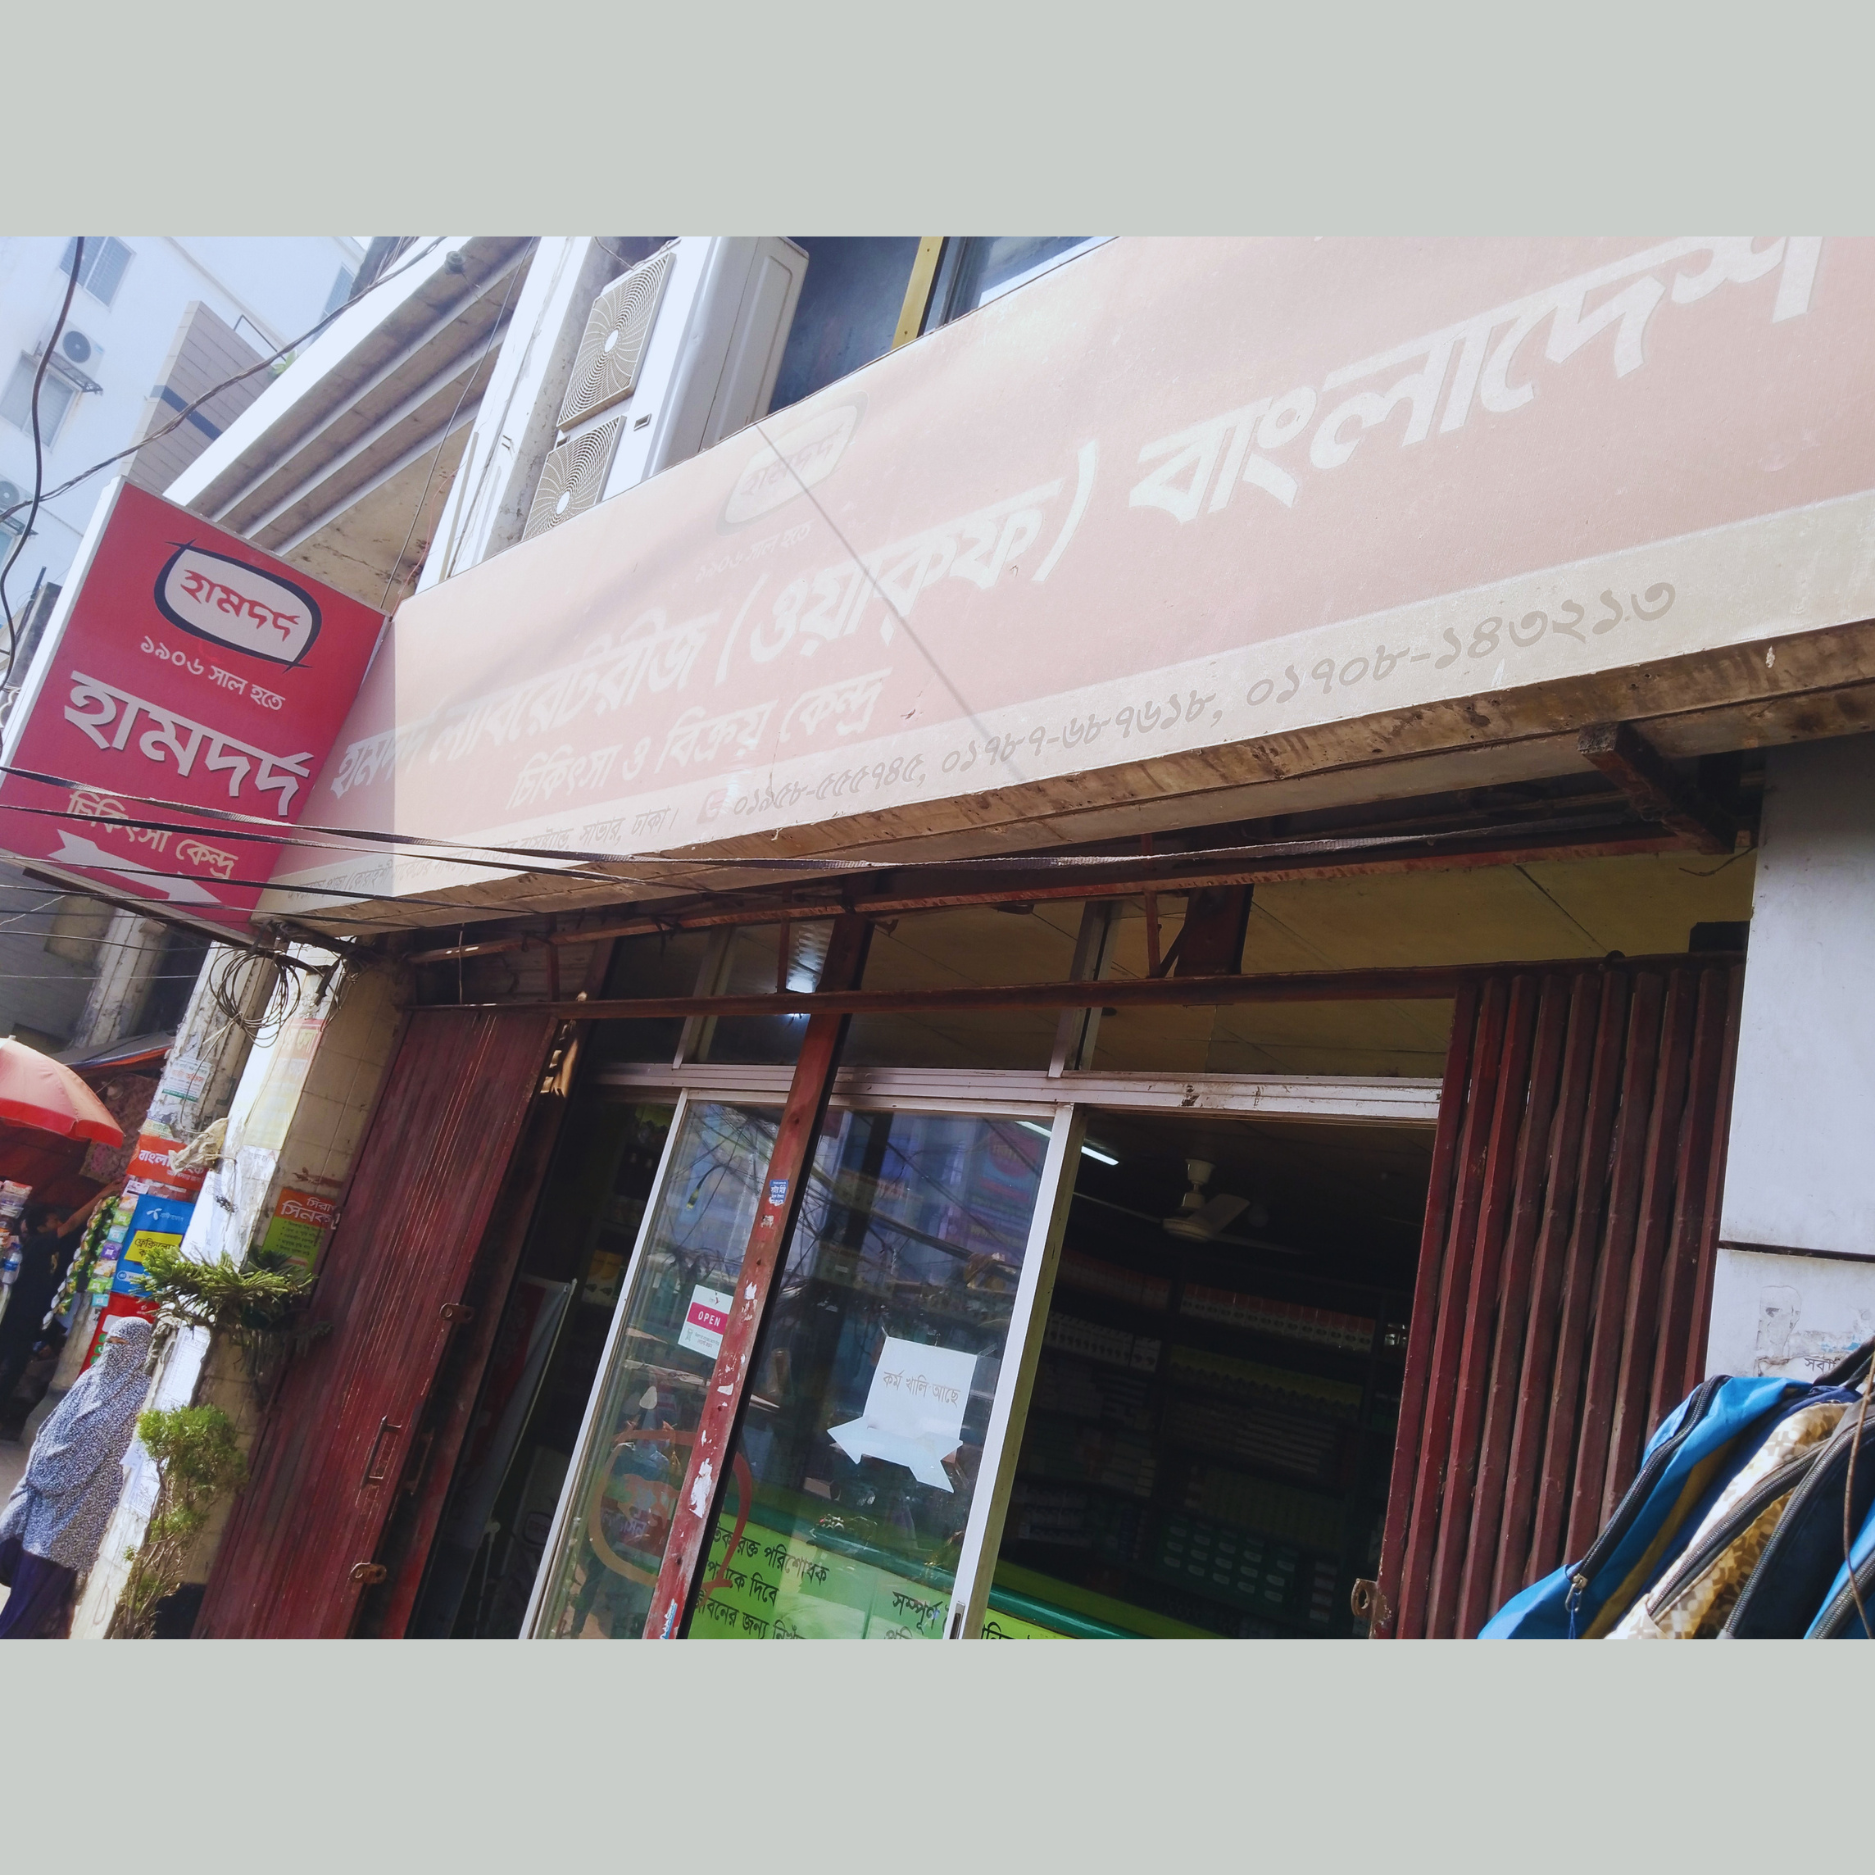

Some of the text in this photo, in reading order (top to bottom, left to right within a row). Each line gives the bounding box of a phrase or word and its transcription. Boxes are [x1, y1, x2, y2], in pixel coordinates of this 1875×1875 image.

[1129, 236, 1824, 526] বাংলাদেশ
[746, 536, 780, 565] সাল
[779, 520, 815, 549] হতে
[181, 569, 300, 642] হামদর্দ
[140, 635, 286, 711] ১৯০৬ সাল হতে
[941, 690, 1223, 774] ০১৭৮৭-৬৮৭৬১৮,
[1247, 581, 1677, 706] ০১৭০৮-১৪৩২১৩
[63, 670, 315, 817] হামদর্দ
[506, 667, 893, 809] চিকিৎসা ও বিক্রয় কেন্দ্র
[67, 789, 239, 880] চিকিৎসা কেন্দ্র
[698, 1310, 721, 1327] OPEN
[883, 1370, 961, 1408] কর্ম খালি আছে
[749, 1572, 779, 1606] দিবে
[764, 1544, 830, 1586] পরিশোধক
[742, 1612, 769, 1639] জন্য
